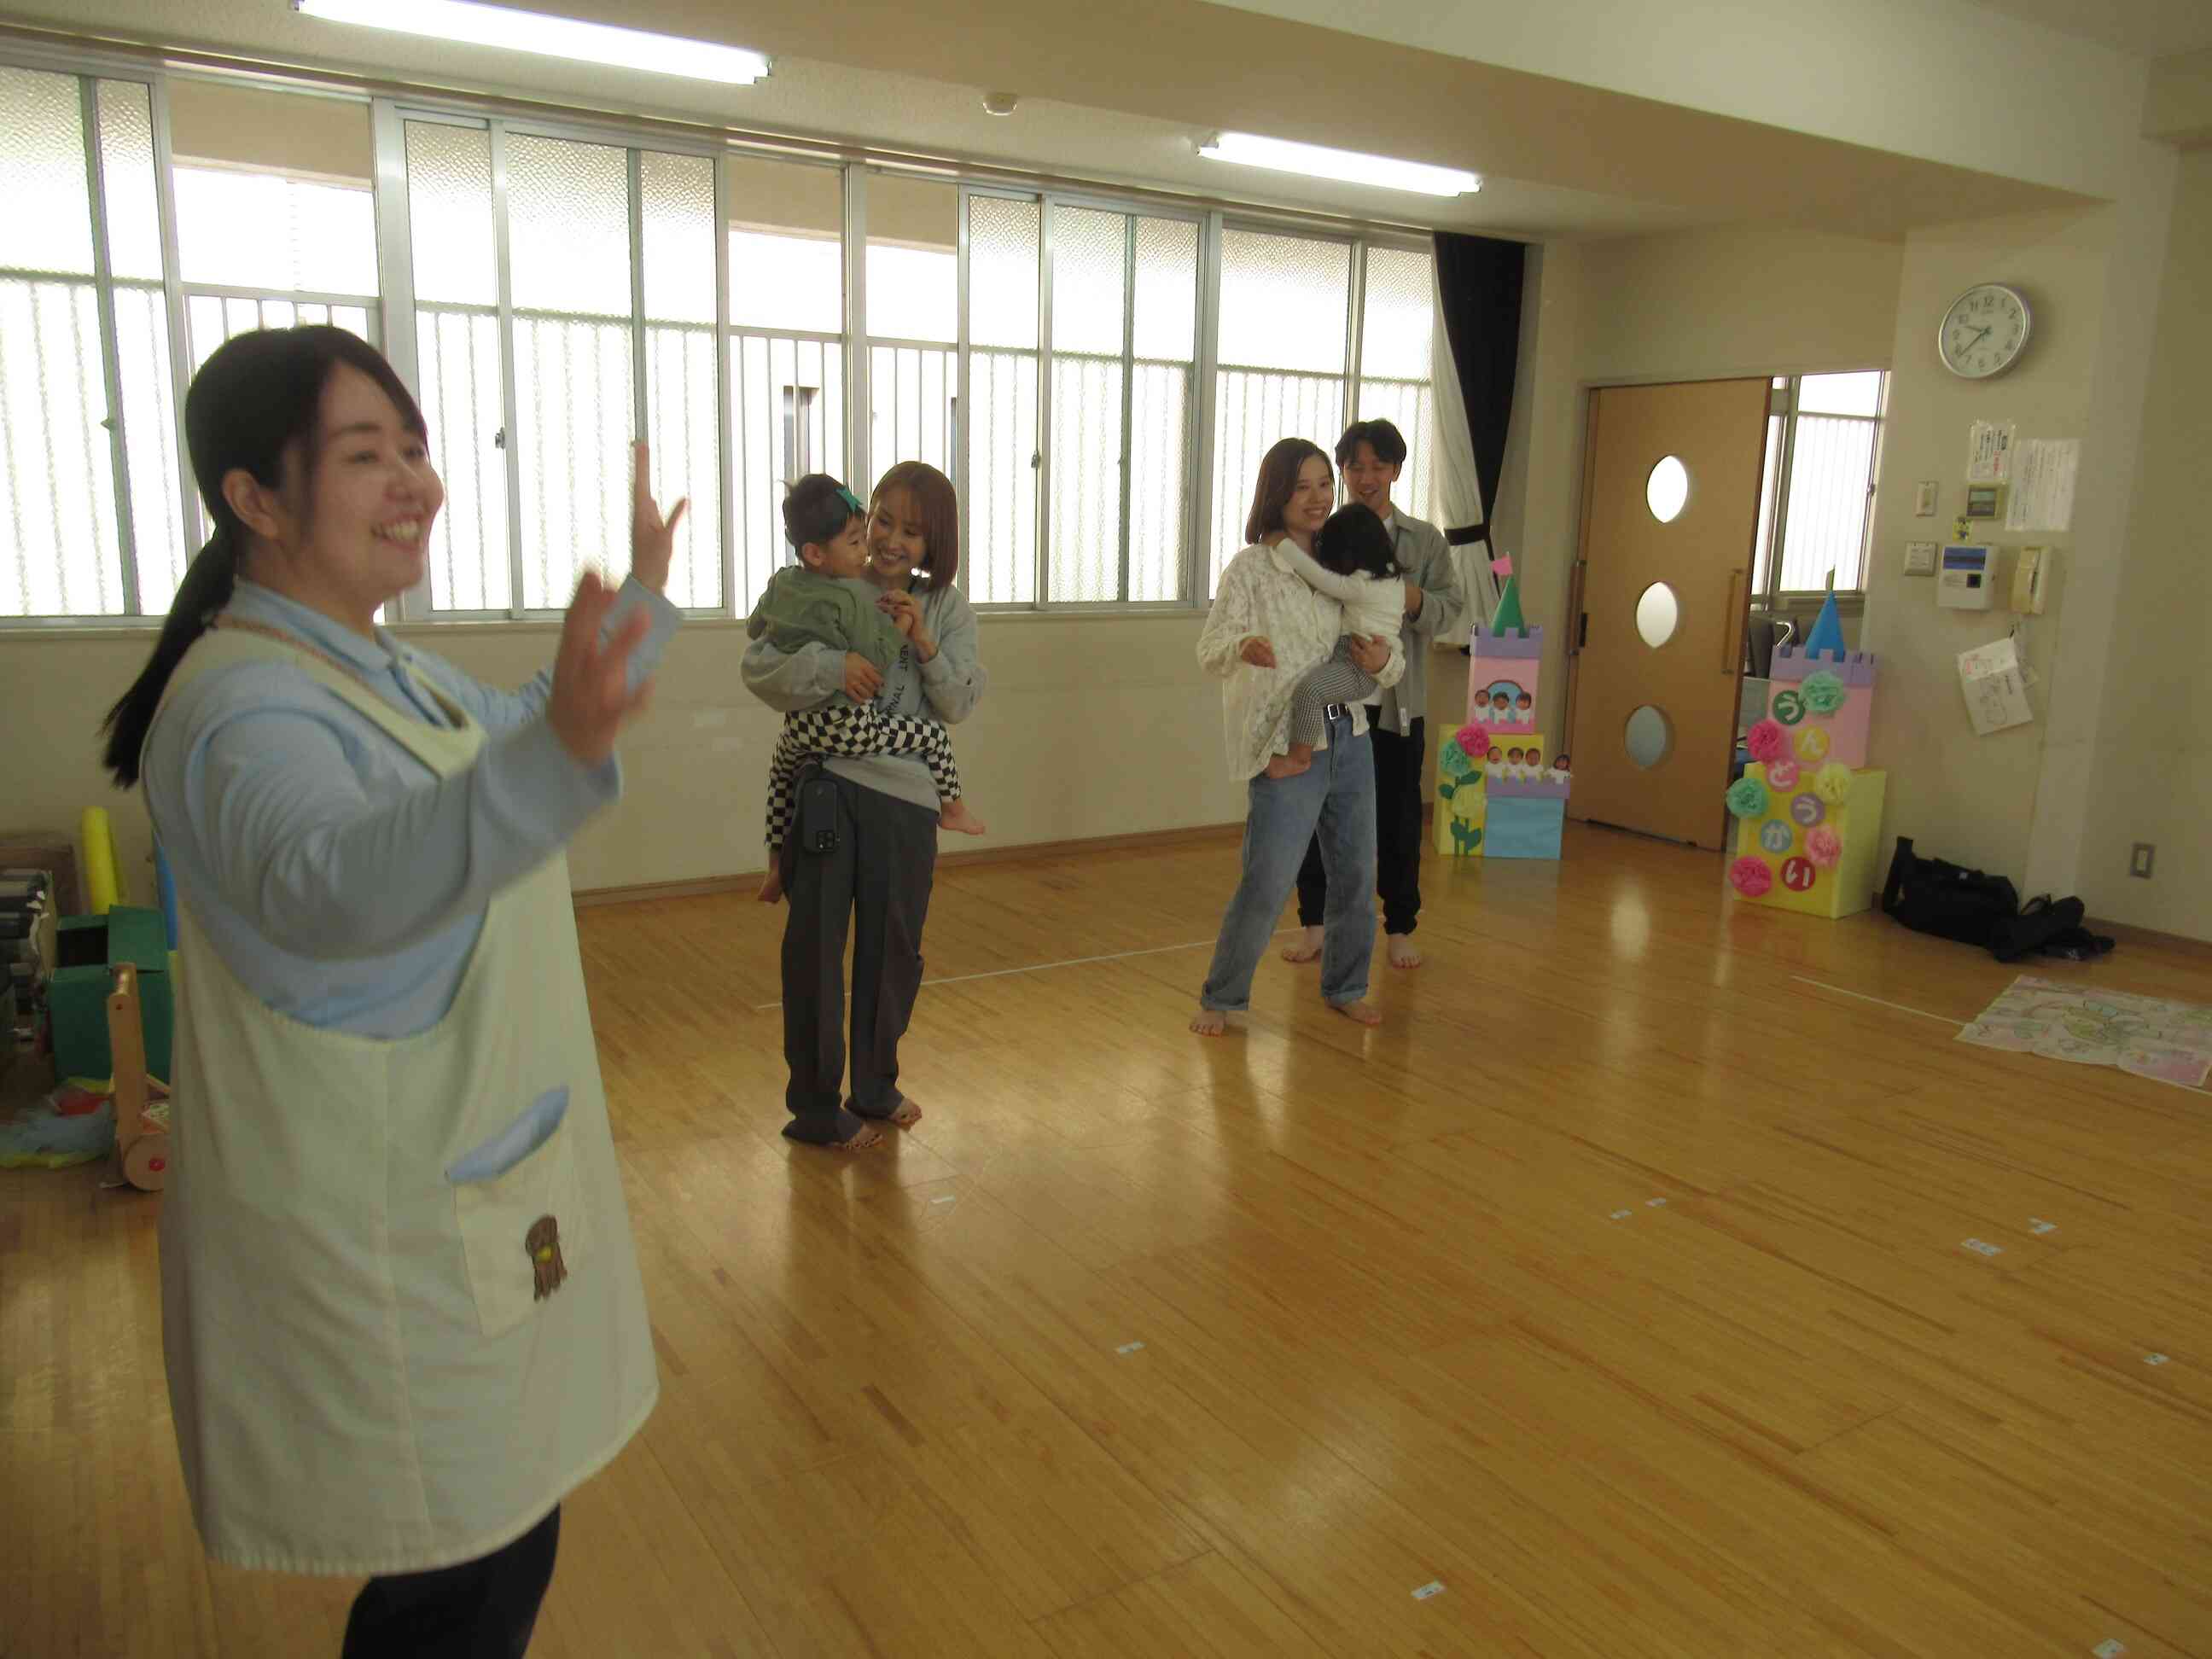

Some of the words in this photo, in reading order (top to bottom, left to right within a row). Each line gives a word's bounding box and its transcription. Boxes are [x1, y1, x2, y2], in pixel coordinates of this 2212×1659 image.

[1970, 299, 1979, 312] 11
[1982, 295, 1994, 307] 12
[2008, 307, 2017, 320] 2
[1952, 329, 1960, 341] 9
[2012, 323, 2020, 335] 3
[1964, 354, 1973, 366] 7
[1977, 358, 1986, 369] 6
